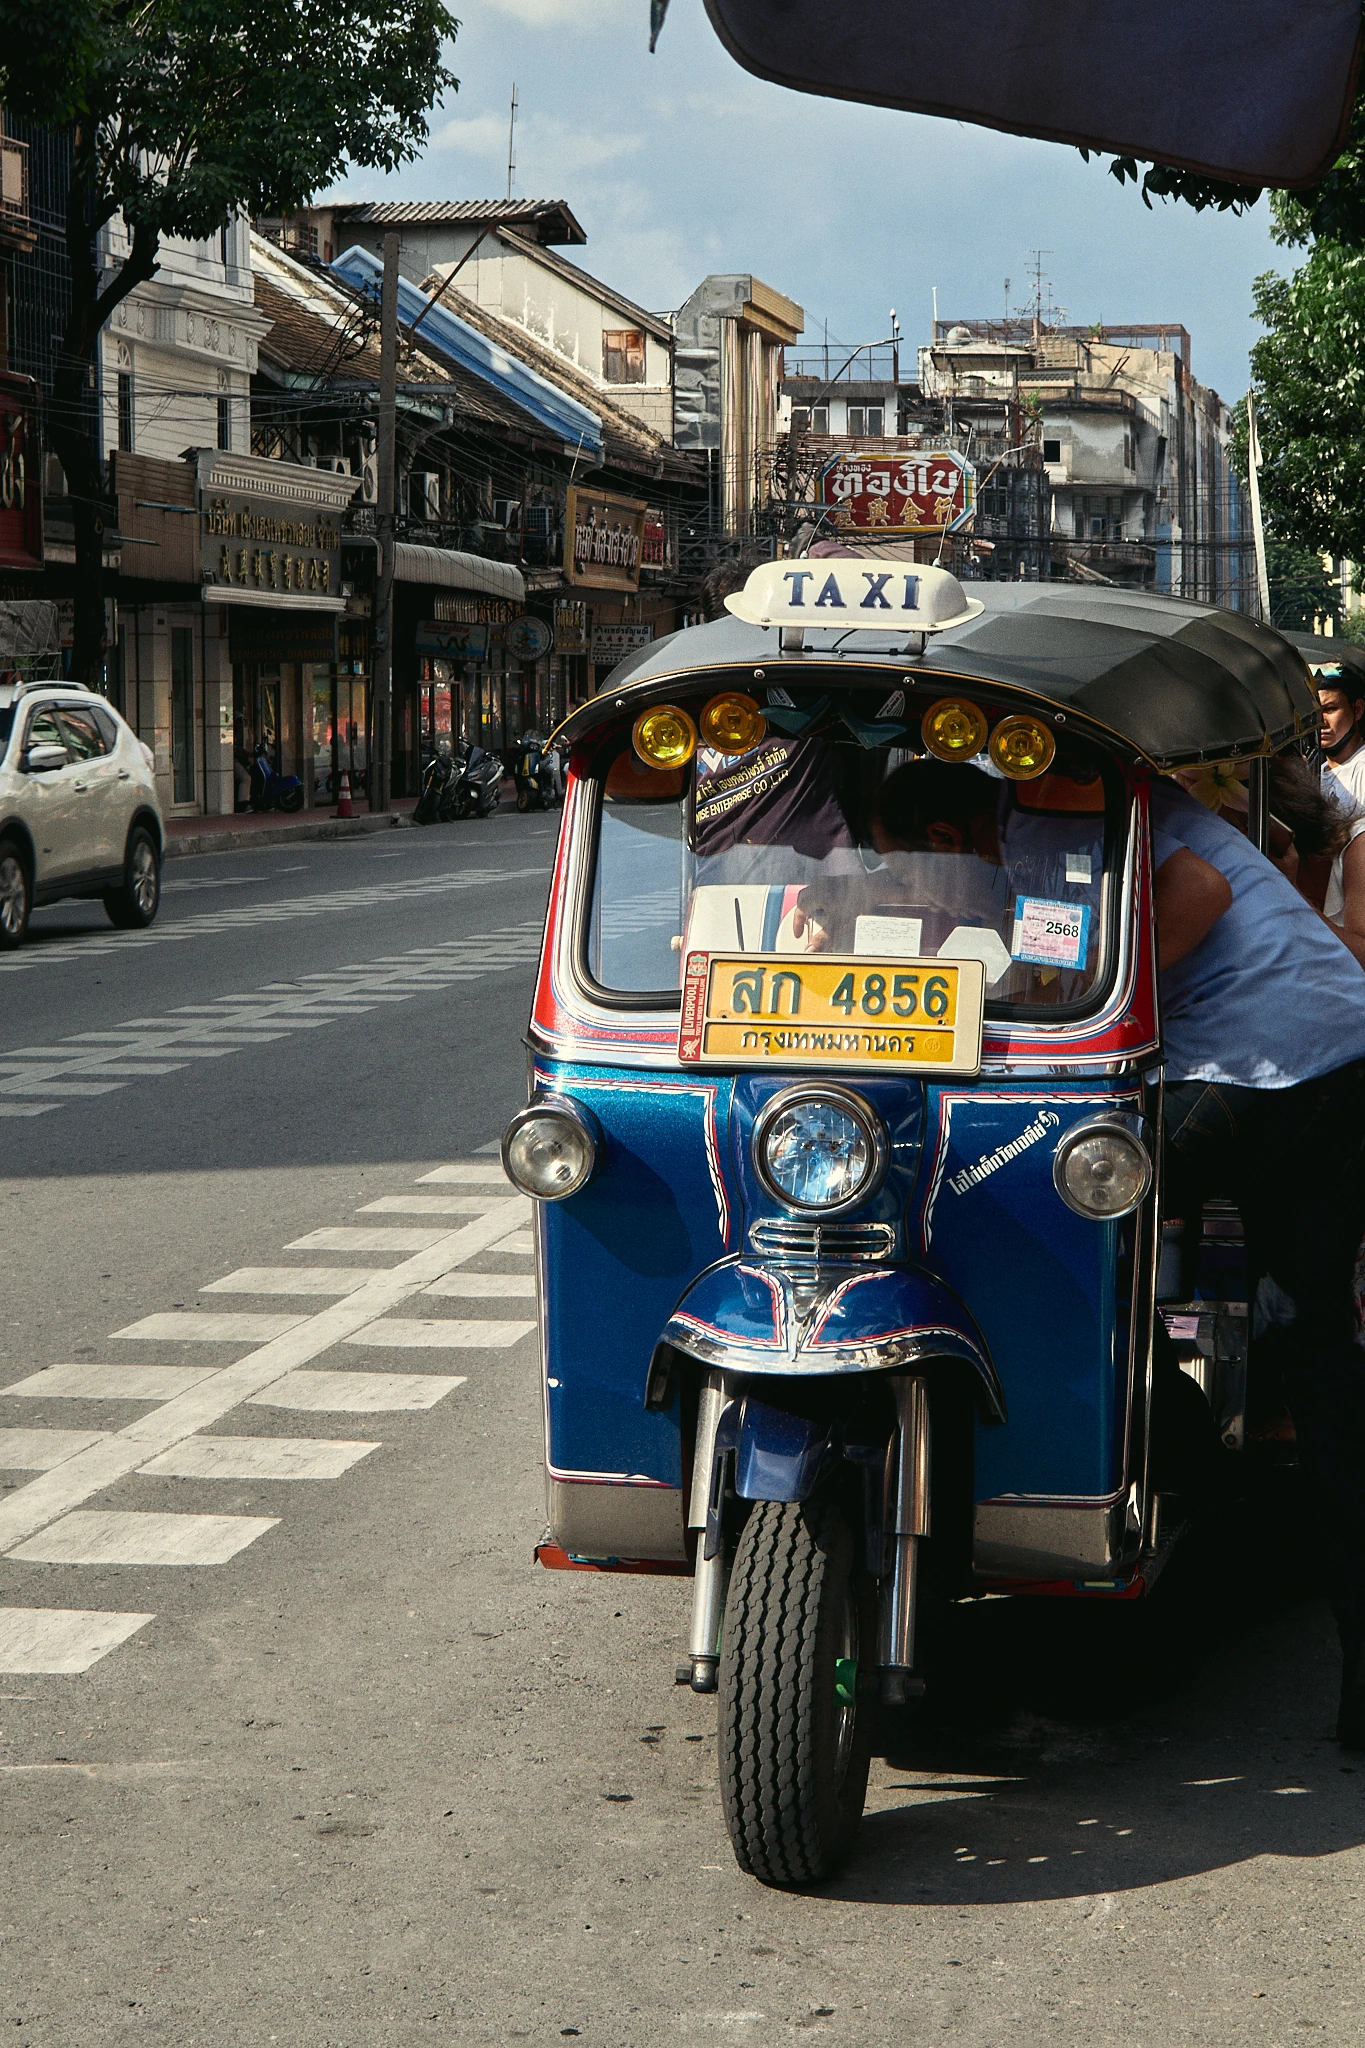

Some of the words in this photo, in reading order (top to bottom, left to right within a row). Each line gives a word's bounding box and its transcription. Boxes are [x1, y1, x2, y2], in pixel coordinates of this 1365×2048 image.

[783, 572, 921, 610] TAXI
[285, 648, 334, 660] DIAMOND
[1045, 921, 1079, 938] 2568
[685, 984, 697, 1028] LIVERPOOL
[731, 967, 802, 1015] สก
[829, 972, 949, 1018] 4856
[740, 1029, 916, 1056] กรุงเทพมหานคร
